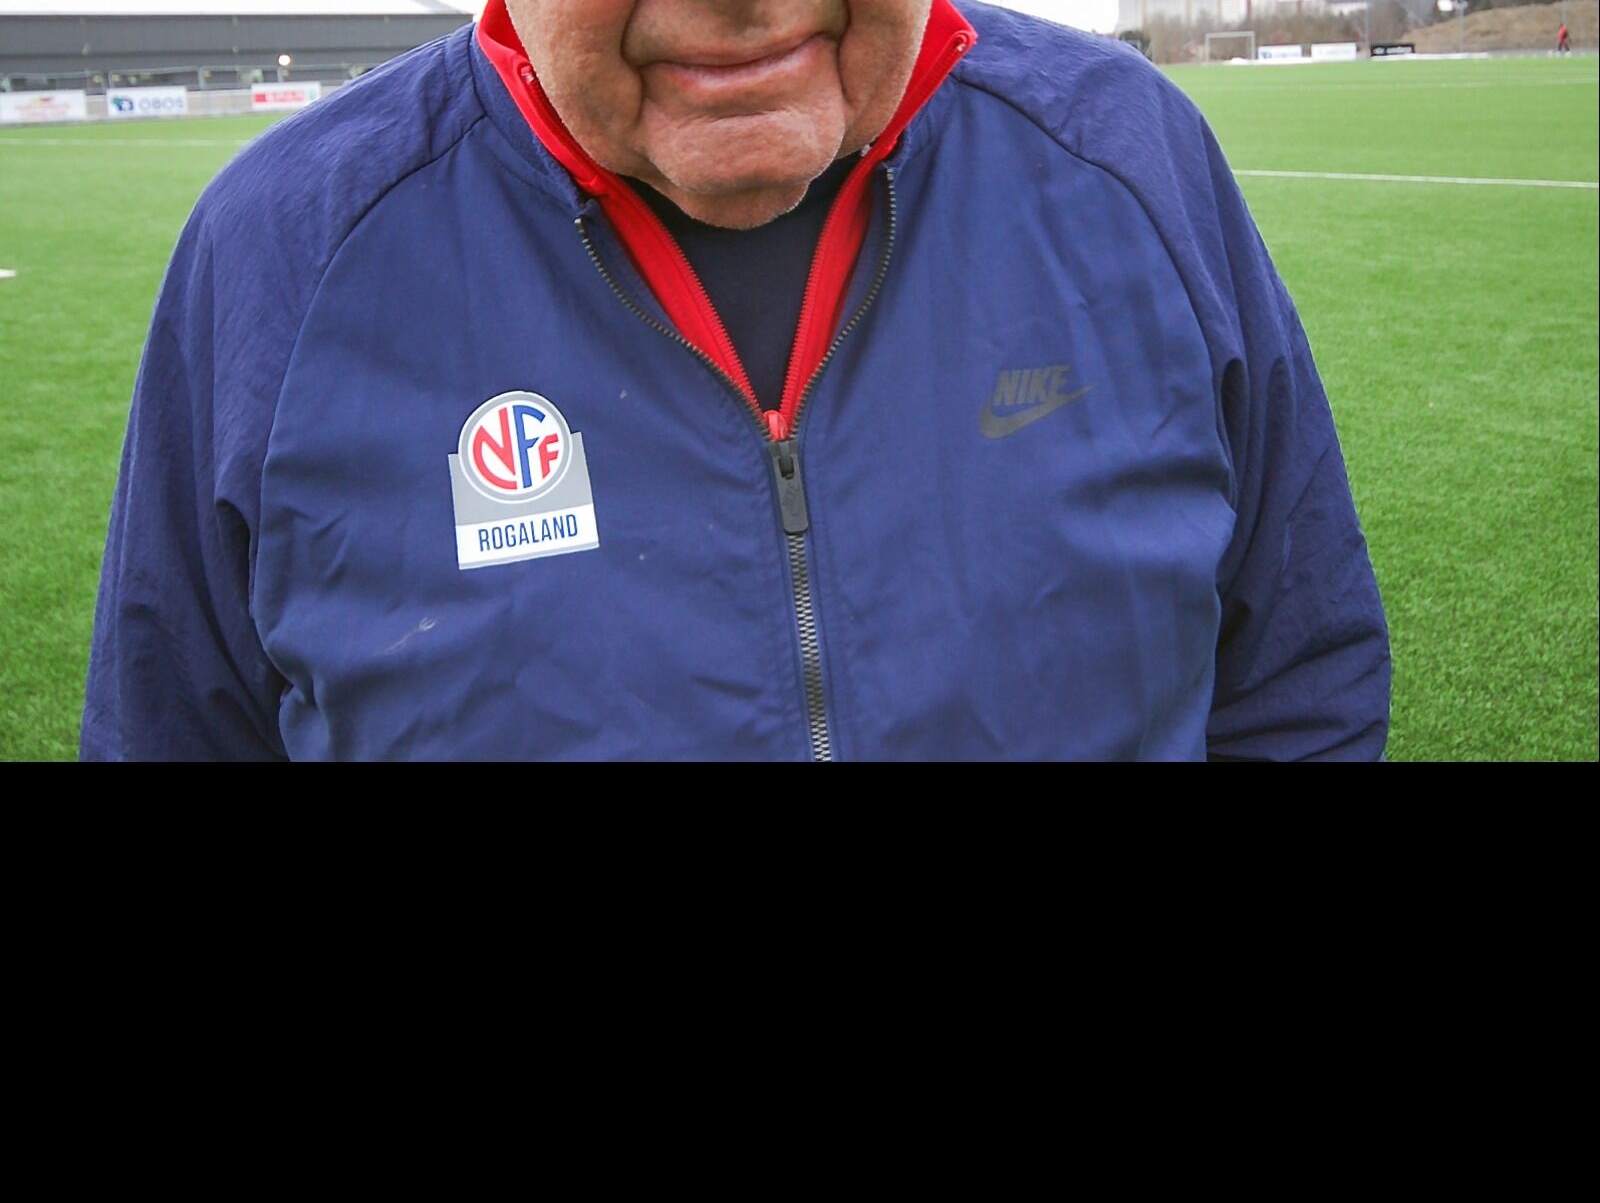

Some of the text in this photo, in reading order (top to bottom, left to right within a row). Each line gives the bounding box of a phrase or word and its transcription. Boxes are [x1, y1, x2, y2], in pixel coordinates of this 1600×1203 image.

[992, 365, 1070, 406] NIKE
[472, 404, 559, 490] NFF
[478, 514, 578, 552] ROGALAND
